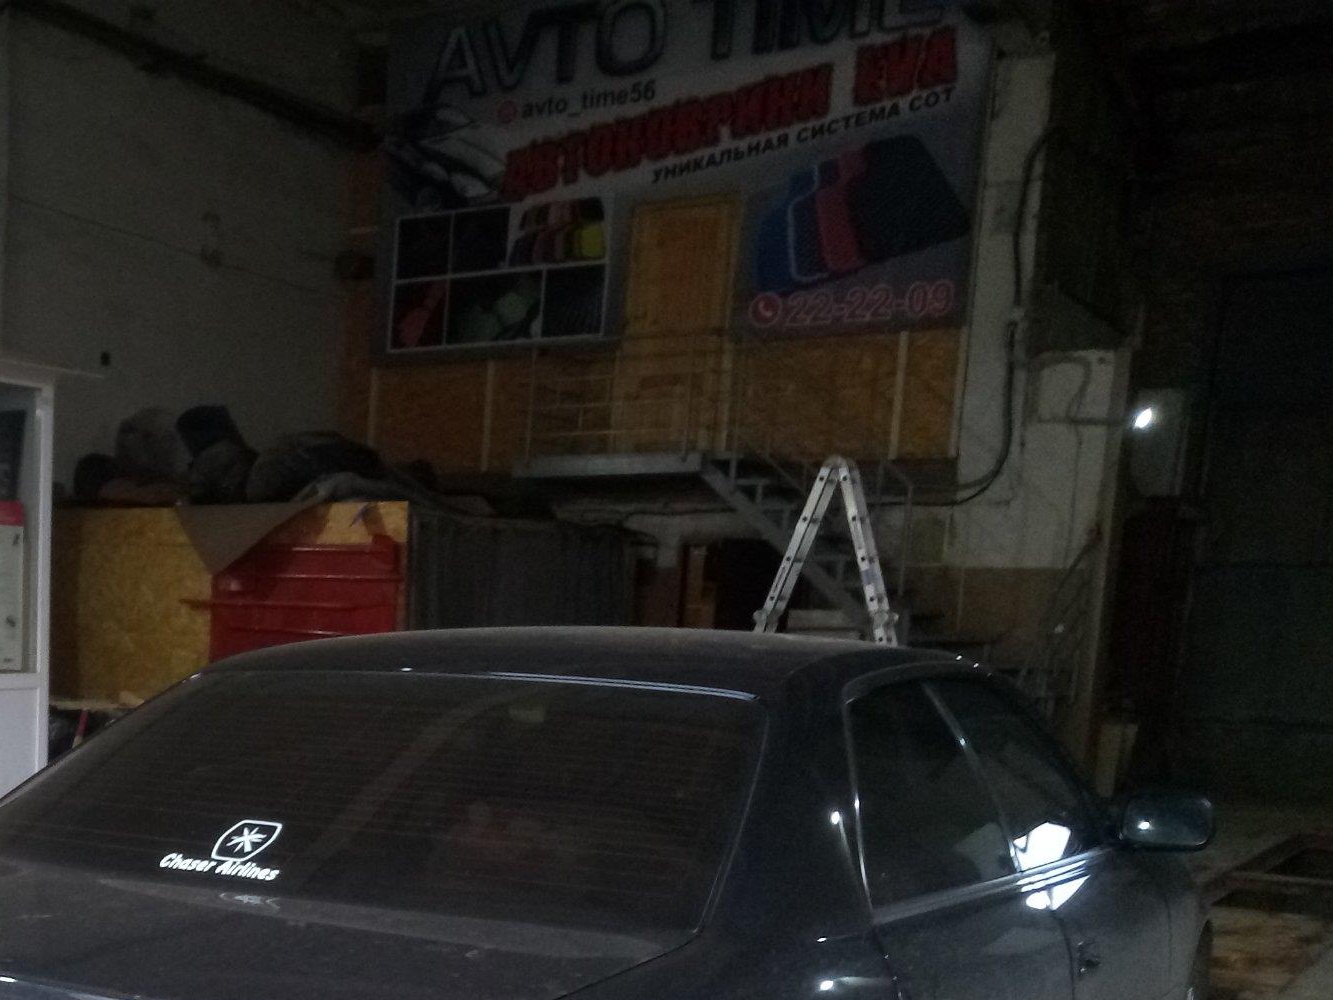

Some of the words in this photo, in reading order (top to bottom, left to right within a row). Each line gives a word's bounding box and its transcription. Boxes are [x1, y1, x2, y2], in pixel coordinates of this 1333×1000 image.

[423, 0, 668, 105] AVTO
[521, 79, 656, 119] avto_time56
[652, 135, 789, 184] УНИКАЛЬНАЯ
[796, 105, 901, 143] СИСТЕМА
[909, 87, 957, 112] СОТ
[783, 278, 955, 329] 22-22-09
[159, 852, 217, 872] Chaser
[214, 859, 280, 881] Airlines
